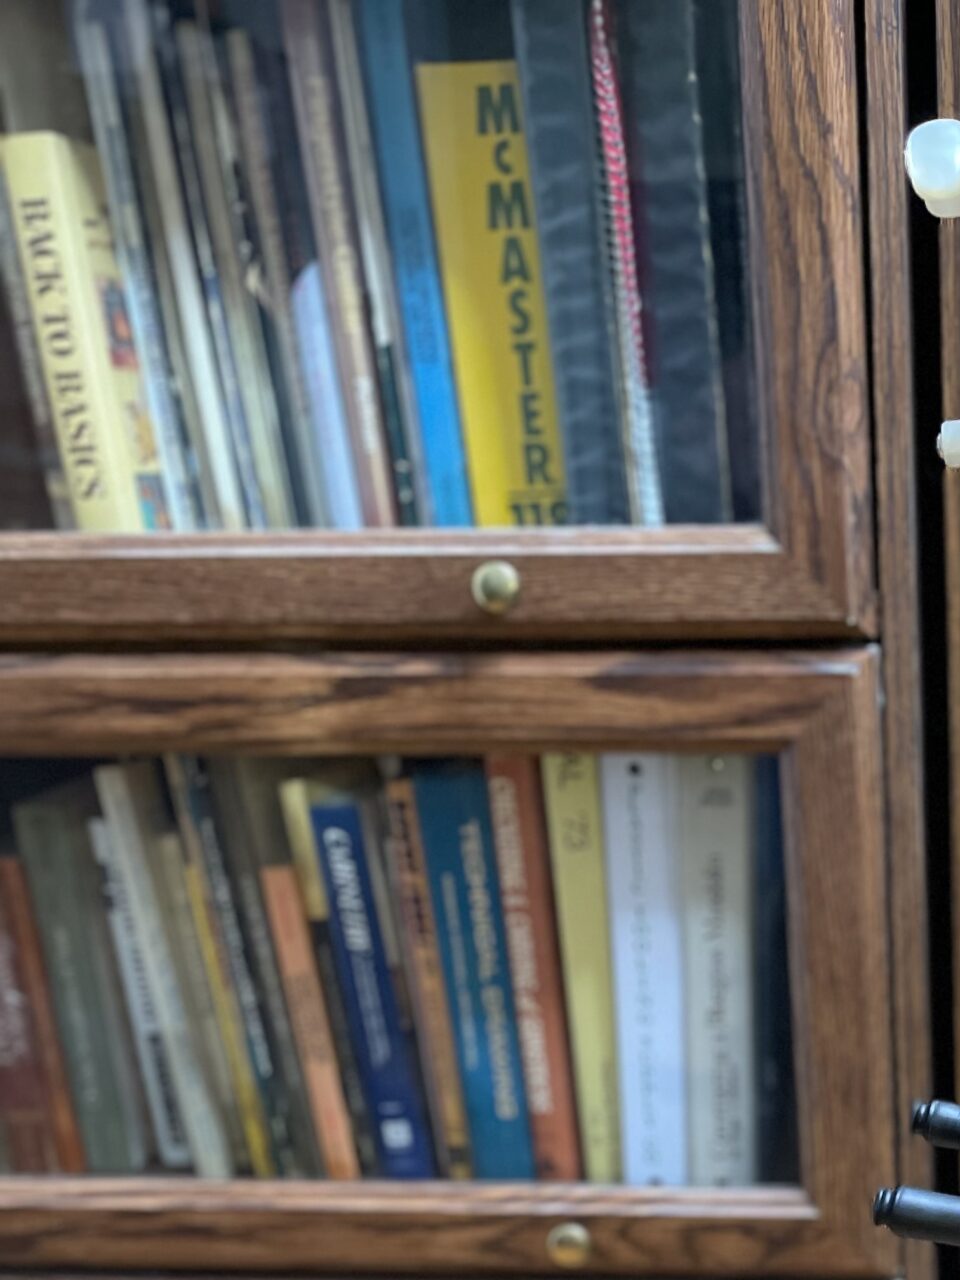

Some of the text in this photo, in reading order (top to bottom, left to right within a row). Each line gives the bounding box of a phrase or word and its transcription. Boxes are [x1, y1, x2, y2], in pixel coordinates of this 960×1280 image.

[20, 197, 105, 499] BACK TO BASICS
[459, 818, 499, 981] TECHNICAL
